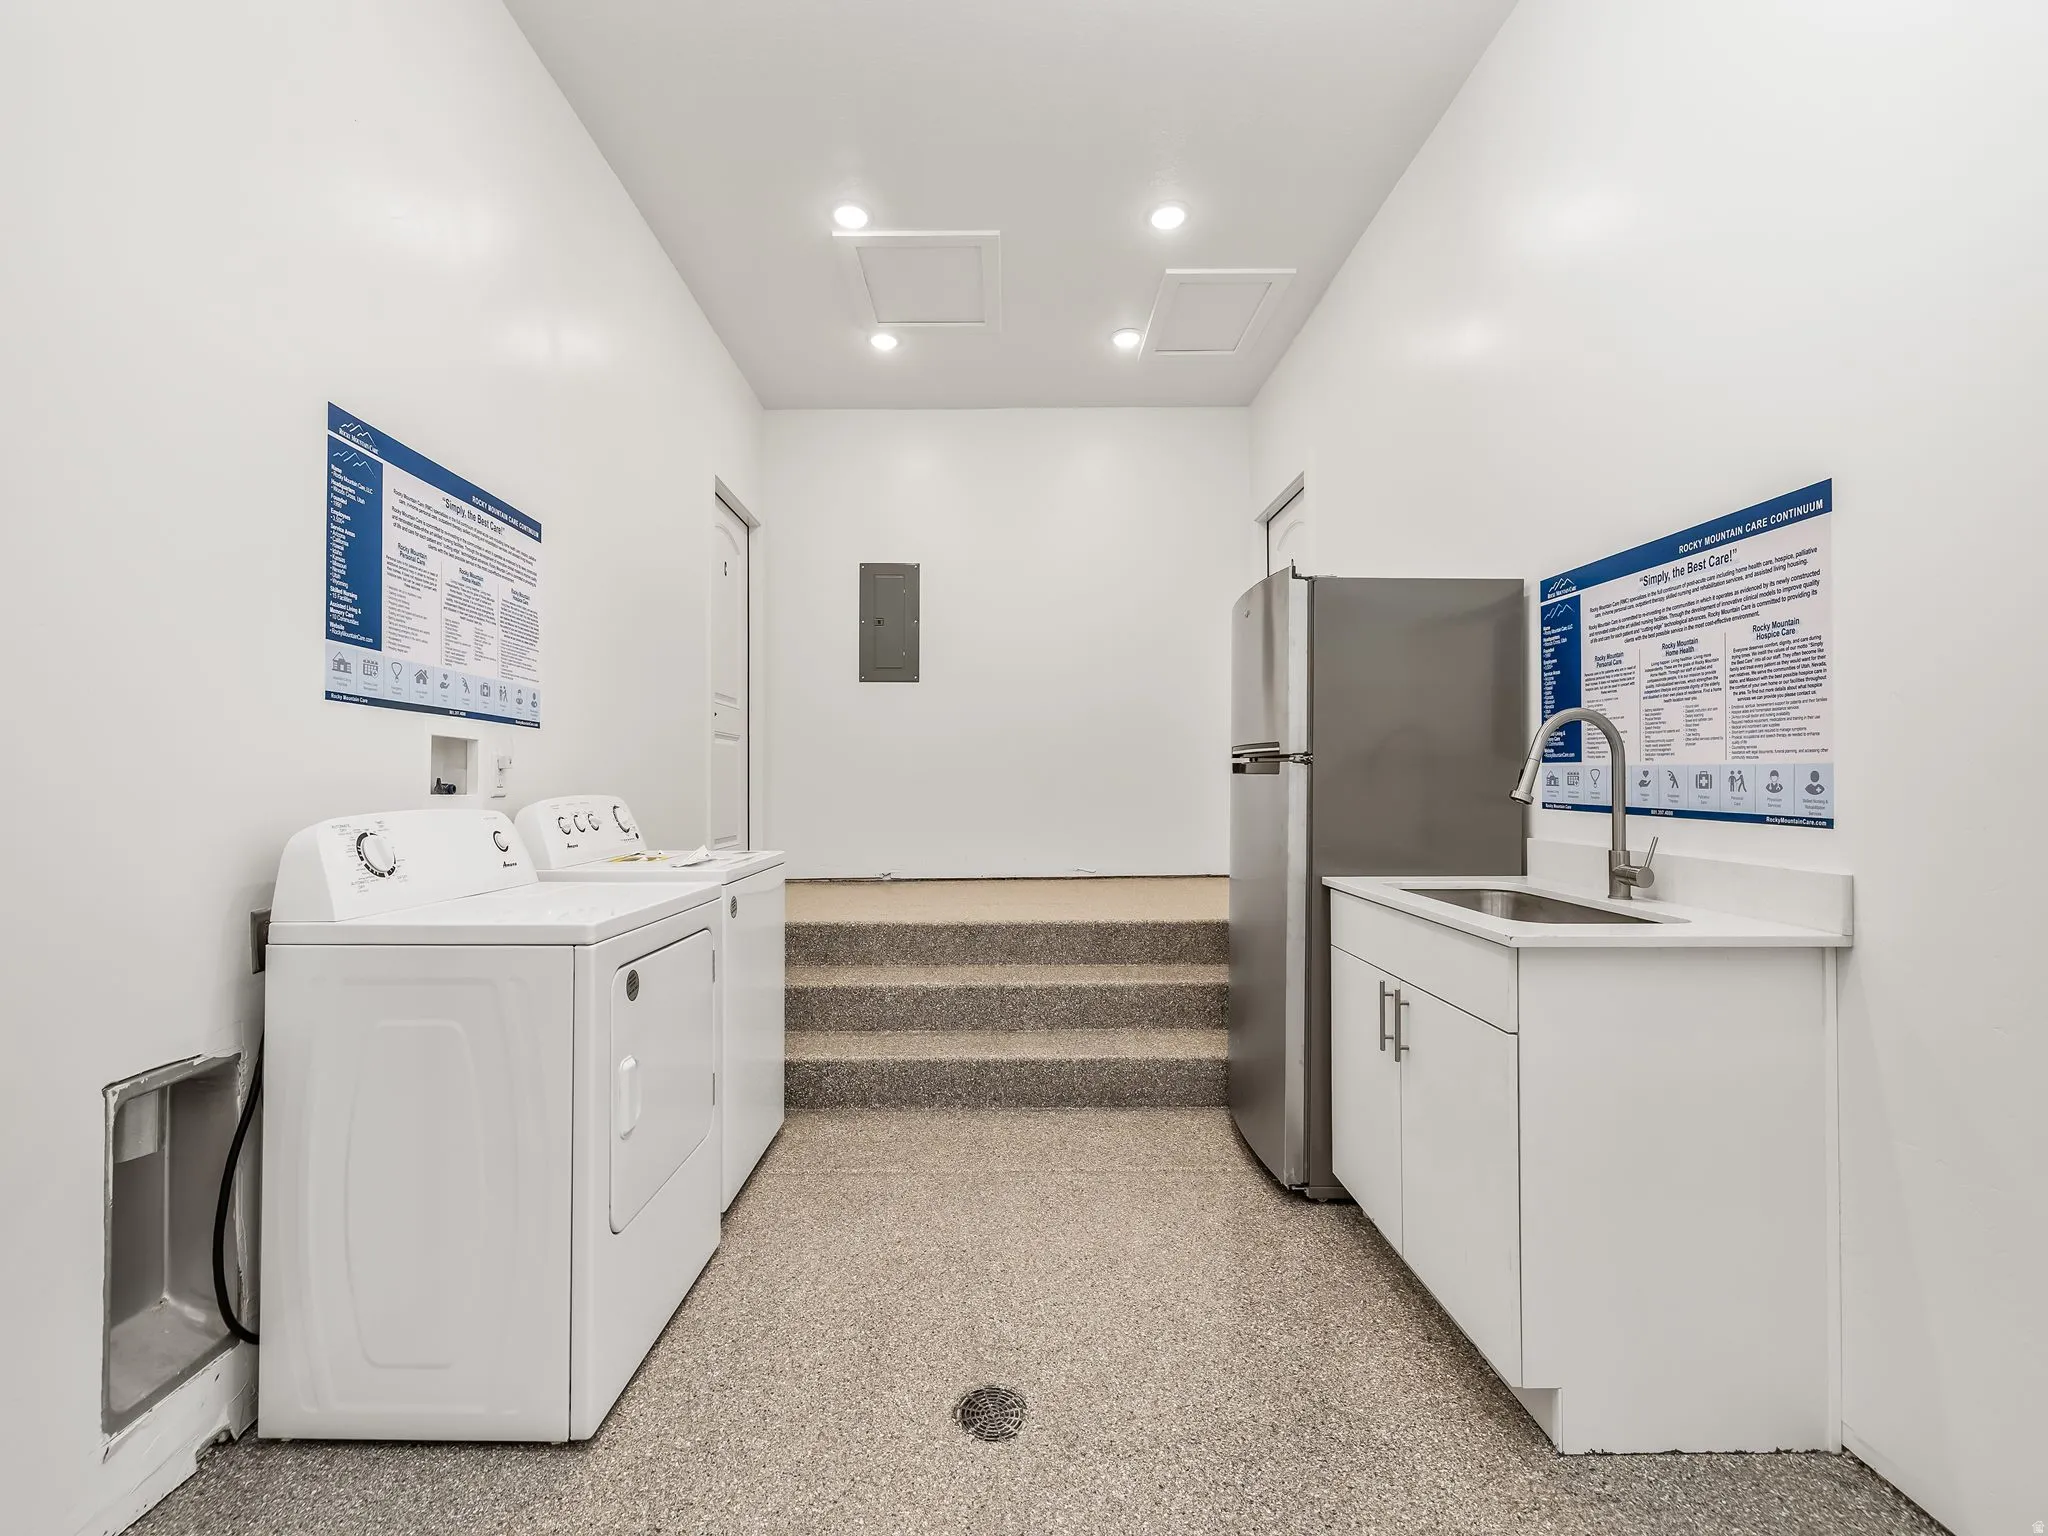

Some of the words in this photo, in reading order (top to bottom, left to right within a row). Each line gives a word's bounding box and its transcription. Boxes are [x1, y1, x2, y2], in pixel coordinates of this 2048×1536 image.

[472, 495, 486, 510] ROCKY
[488, 504, 507, 521] MOUNTAIN
[508, 516, 518, 527] CARE
[519, 521, 538, 538] CONTINUUM
[477, 514, 488, 528] Best
[1679, 538, 1702, 554] ROCKY
[1704, 525, 1742, 546] MOUNTAIN
[1745, 516, 1767, 532] CARE
[1770, 498, 1822, 524] CONTINUUM
[398, 542, 409, 554] Rocky
[410, 548, 426, 559] Mountain
[400, 551, 415, 562] Personal
[416, 557, 425, 566] Care
[459, 567, 469, 577] Rocky
[1663, 583, 1681, 593] continuum
[1716, 568, 1734, 580] including
[1735, 565, 1746, 574] home
[1748, 560, 1761, 570] health
[1795, 545, 1816, 559] palliative
[1672, 564, 1684, 578] the
[1687, 557, 1705, 573] Best
[1677, 588, 1691, 597] nursing
[1700, 579, 1724, 590] rehabilitation
[1754, 566, 1772, 576] assisted
[1773, 563, 1785, 572] living
[1672, 600, 1694, 610] communities
[1715, 590, 1733, 600] operates
[1740, 583, 1761, 593] evidenced
[1776, 576, 1789, 586] newly
[1790, 568, 1820, 581] constructed
[1669, 610, 1683, 619] Through
[1691, 603, 1715, 614] development
[1721, 596, 1742, 606] innovative
[1743, 593, 1757, 601] clinical
[1758, 588, 1775, 598] models
[1782, 582, 1801, 594] improve
[1802, 578, 1819, 589] quality
[329, 607, 344, 616] Memory
[330, 600, 345, 609] Assisted
[346, 605, 357, 613] Living
[1664, 618, 1686, 628] technological
[1707, 610, 1720, 619] Rocky
[1720, 606, 1739, 615] Mountain
[1756, 596, 1780, 607] committed
[1787, 590, 1809, 602] providing
[1752, 622, 1769, 633] Rocky
[1772, 616, 1799, 628] Mountain
[1655, 629, 1669, 638] possible
[1756, 629, 1779, 641] Hospice
[1781, 626, 1795, 635] Care
[1661, 641, 1675, 651] Rocky
[1676, 636, 1698, 646] Mountain
[1595, 654, 1605, 662] Rocky
[1606, 650, 1623, 659] Mountain
[331, 693, 342, 701] Rocky
[1766, 816, 1826, 827] RockyMountainCare.com
